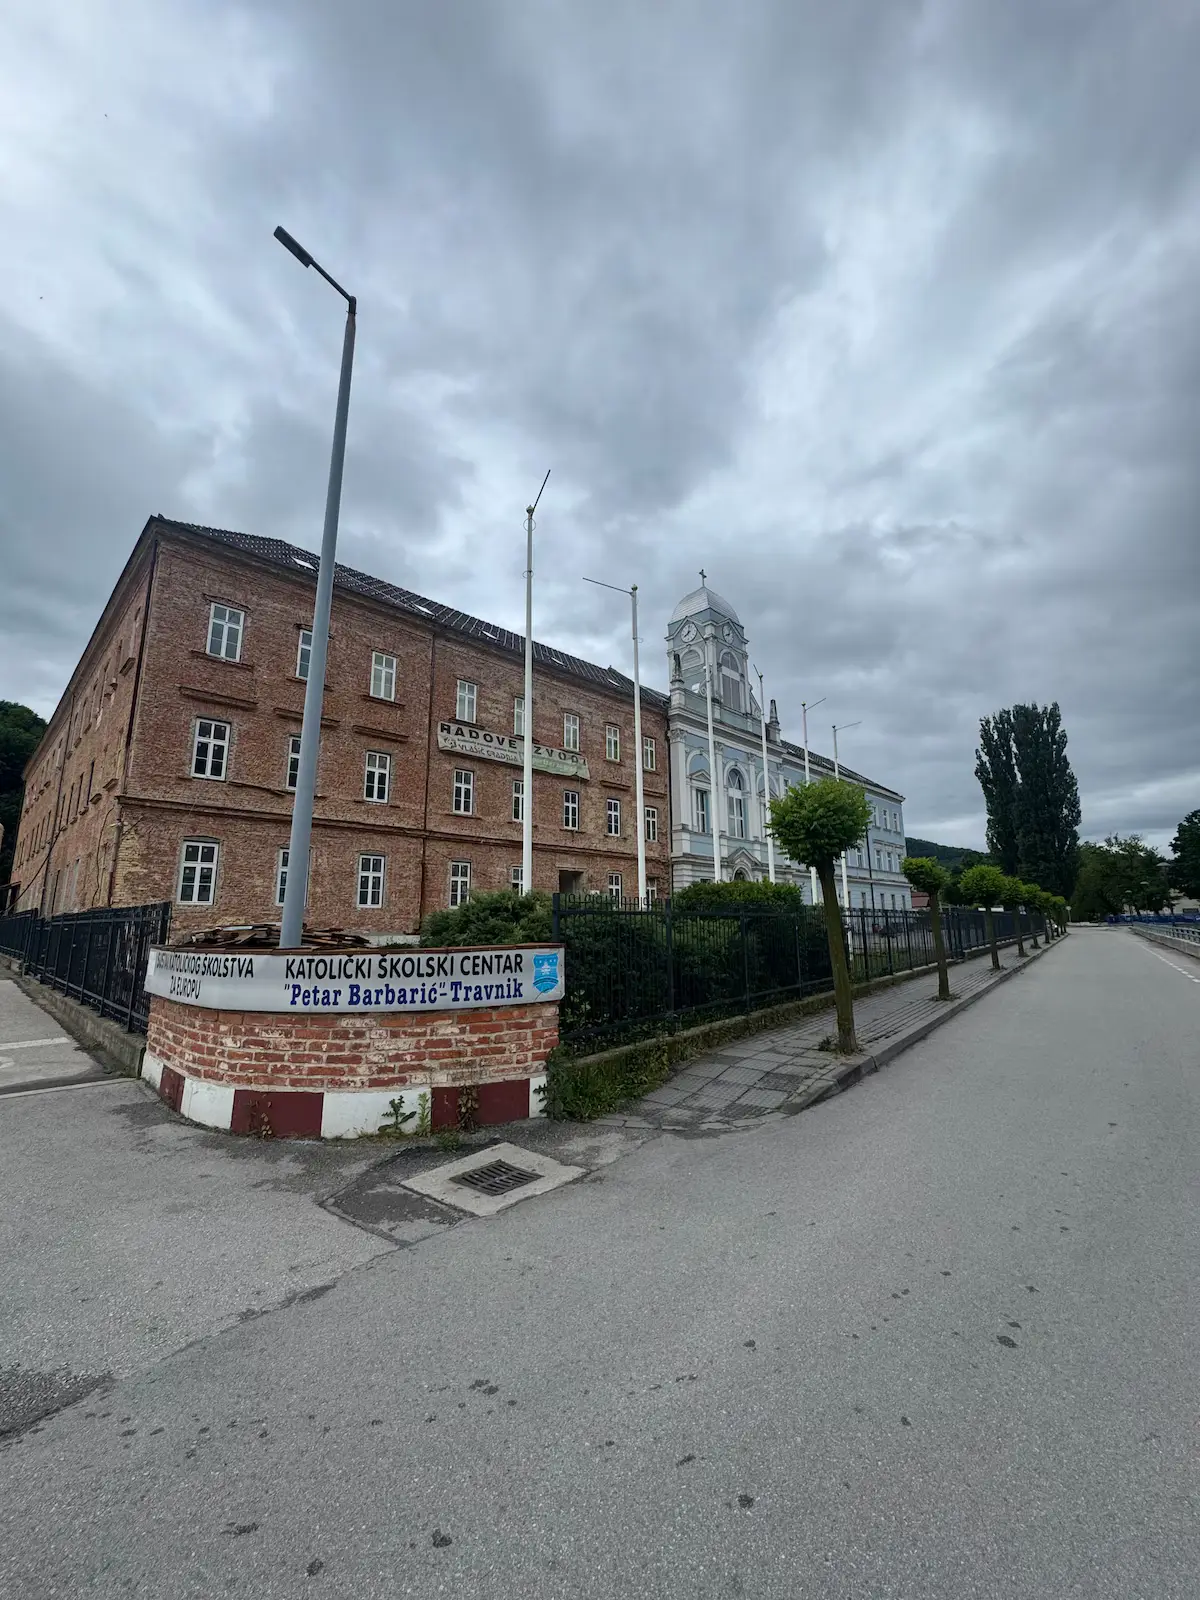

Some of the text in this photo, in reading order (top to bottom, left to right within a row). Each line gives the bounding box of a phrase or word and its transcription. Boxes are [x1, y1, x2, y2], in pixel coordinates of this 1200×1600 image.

[440, 722, 518, 749] RADOVE
[532, 745, 587, 766] ZVODI
[201, 953, 254, 978] ŠKOLSTVA
[285, 953, 523, 979] KATOLIČKI ŠKOLSKI CENTAR
[176, 976, 201, 1000] EUROPU
